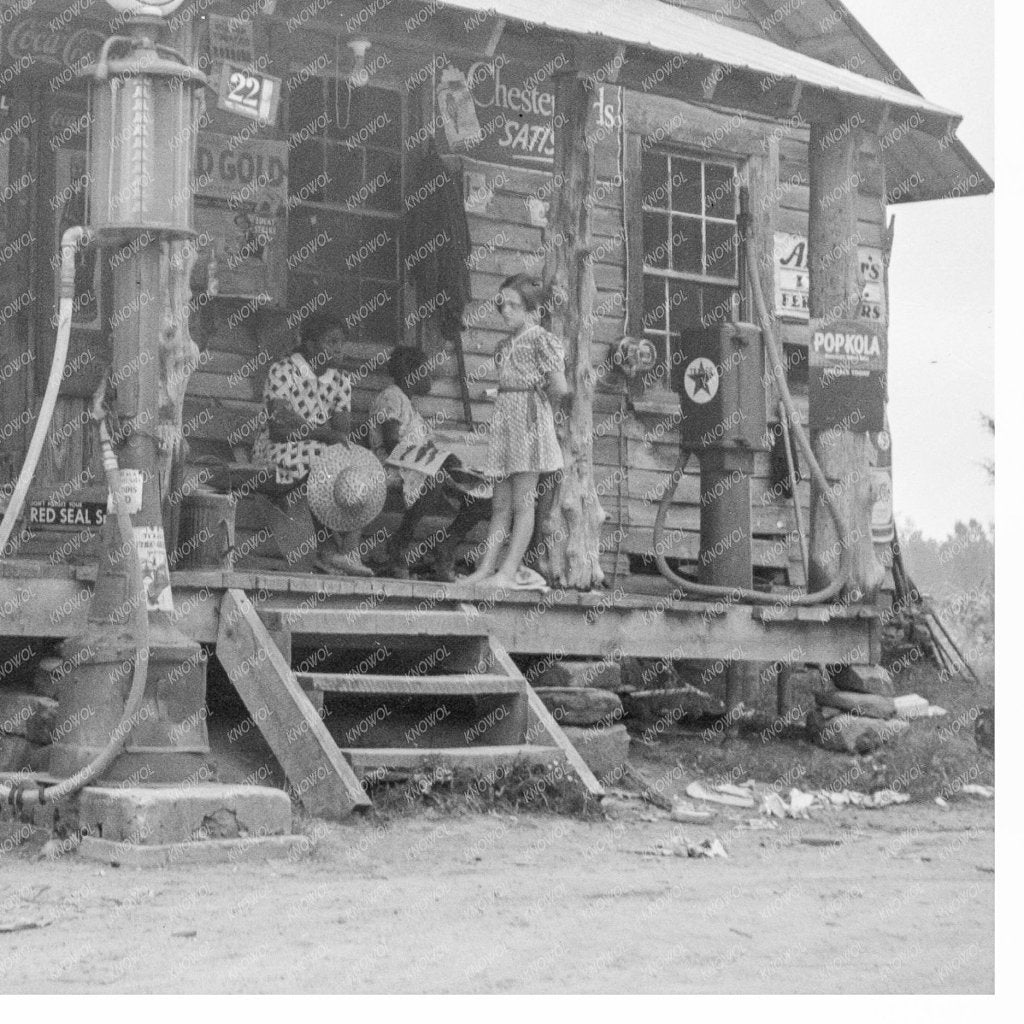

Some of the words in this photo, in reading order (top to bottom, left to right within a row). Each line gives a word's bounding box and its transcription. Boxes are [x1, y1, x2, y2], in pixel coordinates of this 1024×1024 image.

[228, 72, 260, 107] 22
[219, 149, 285, 187] GOLD
[30, 507, 55, 523] RED
[59, 508, 91, 524] SEAL
